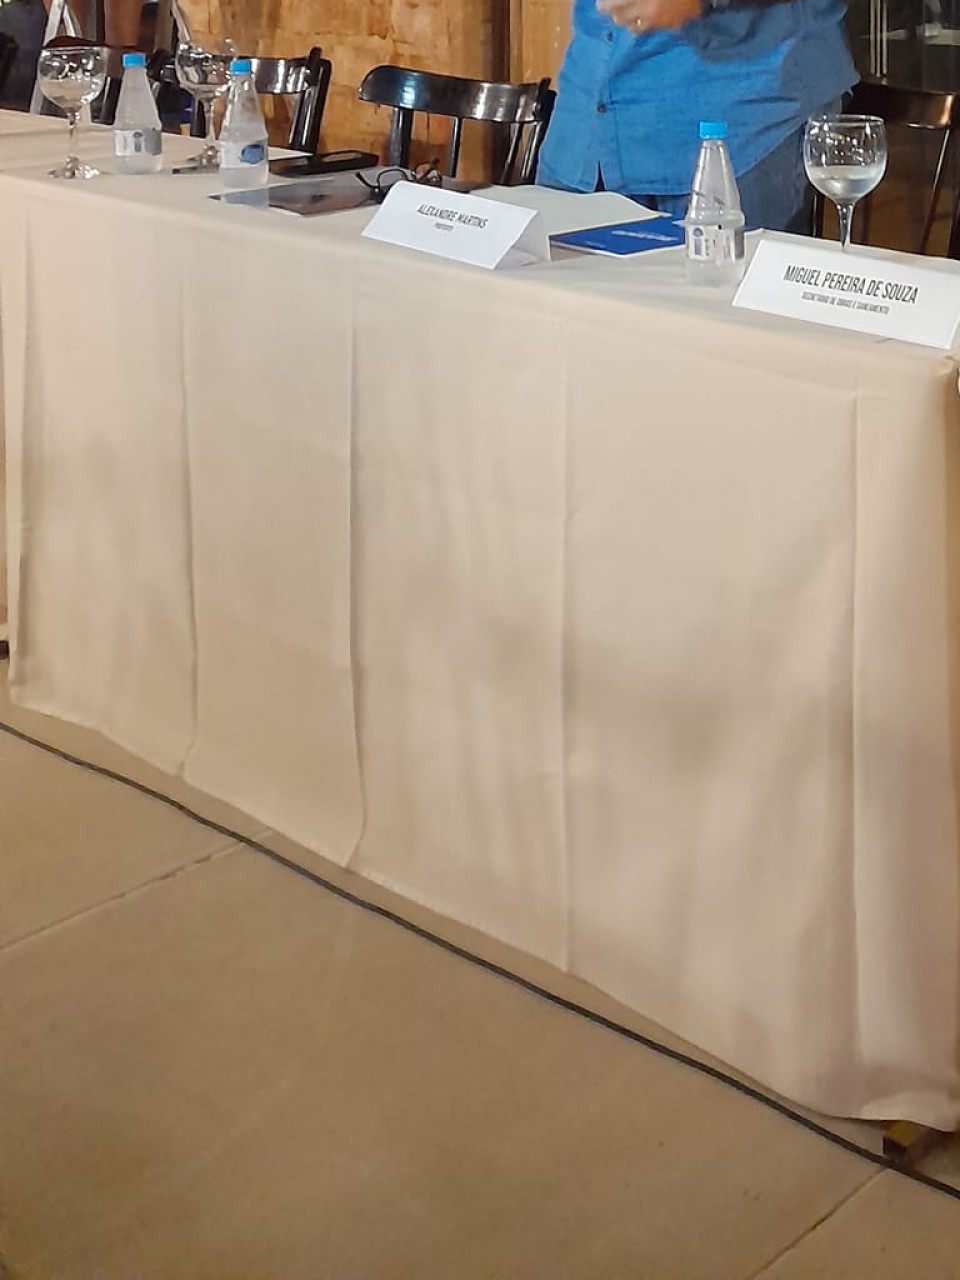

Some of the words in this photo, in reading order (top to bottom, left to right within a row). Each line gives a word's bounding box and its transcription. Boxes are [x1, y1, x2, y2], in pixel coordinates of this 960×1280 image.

[784, 265, 820, 286] MIGUEL
[822, 271, 865, 294] PEREIRA
[865, 280, 883, 296] DE
[882, 282, 918, 304] SOUZA
